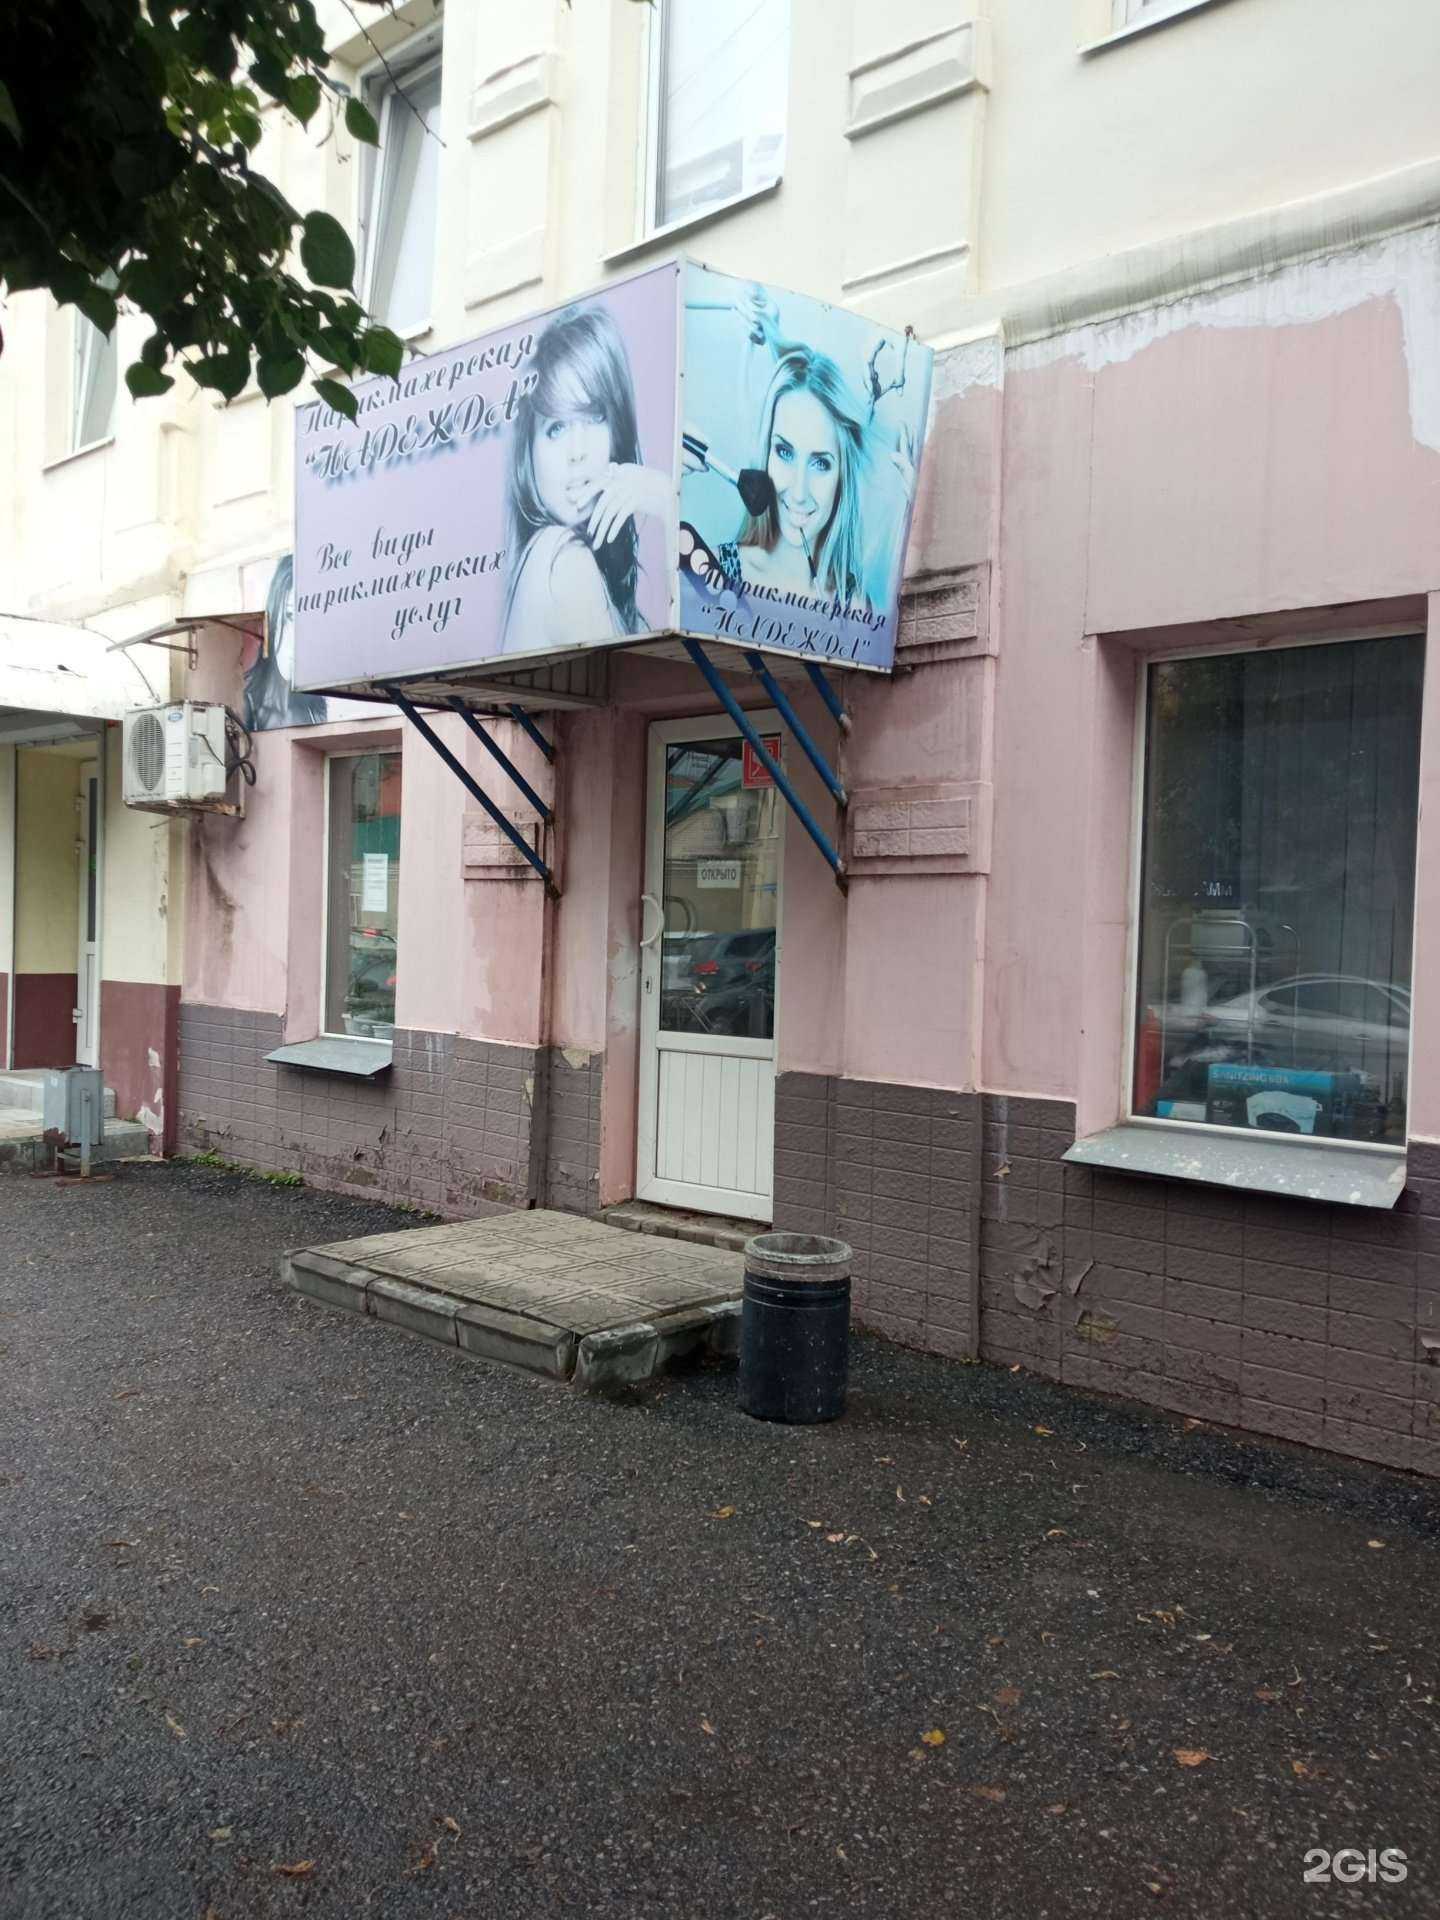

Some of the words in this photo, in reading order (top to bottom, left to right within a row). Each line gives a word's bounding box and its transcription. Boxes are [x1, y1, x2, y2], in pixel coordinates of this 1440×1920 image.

[317, 541, 353, 572] Все
[372, 526, 435, 567] виды
[297, 549, 507, 614] парикмахерских
[699, 562, 887, 632] Парикмахерская
[391, 597, 463, 641] услуг
[701, 868, 737, 880] ОТКРЫТО
